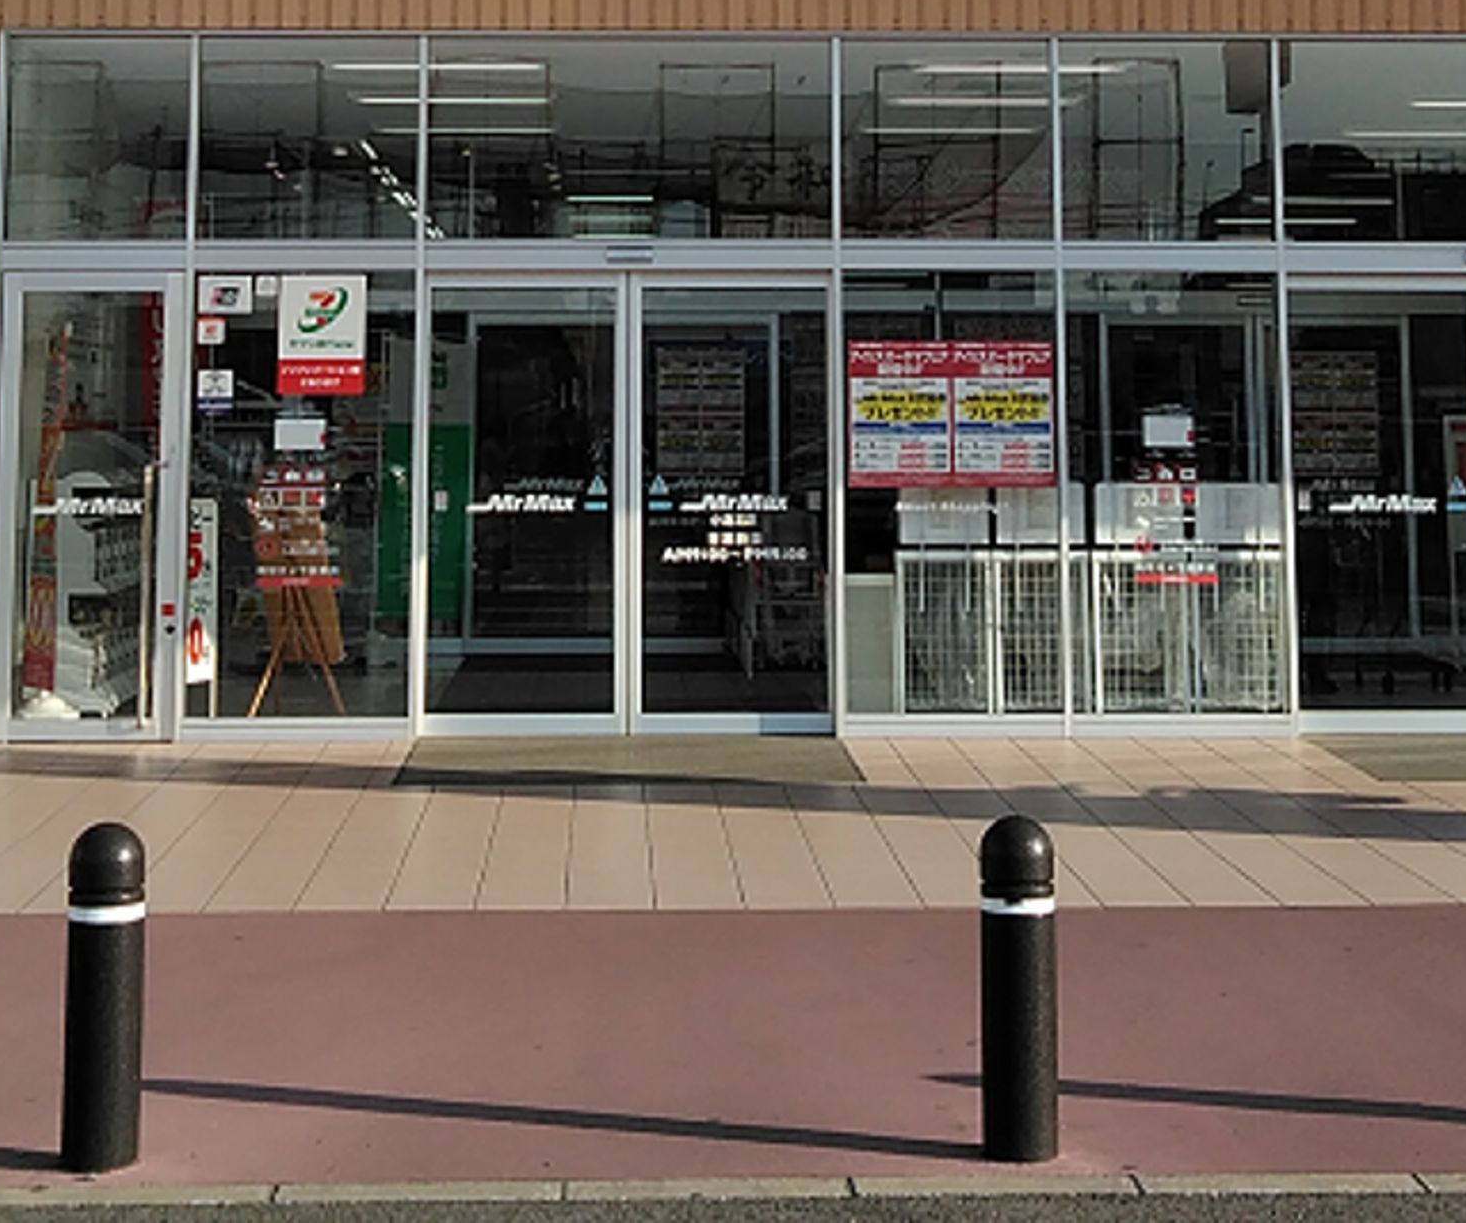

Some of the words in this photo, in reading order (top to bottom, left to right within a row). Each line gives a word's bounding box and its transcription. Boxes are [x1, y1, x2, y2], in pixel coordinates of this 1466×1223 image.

[32, 496, 145, 515] MrMax
[466, 494, 575, 513] MrMax
[679, 493, 788, 512] MrMax
[1328, 494, 1437, 513] MrMax
